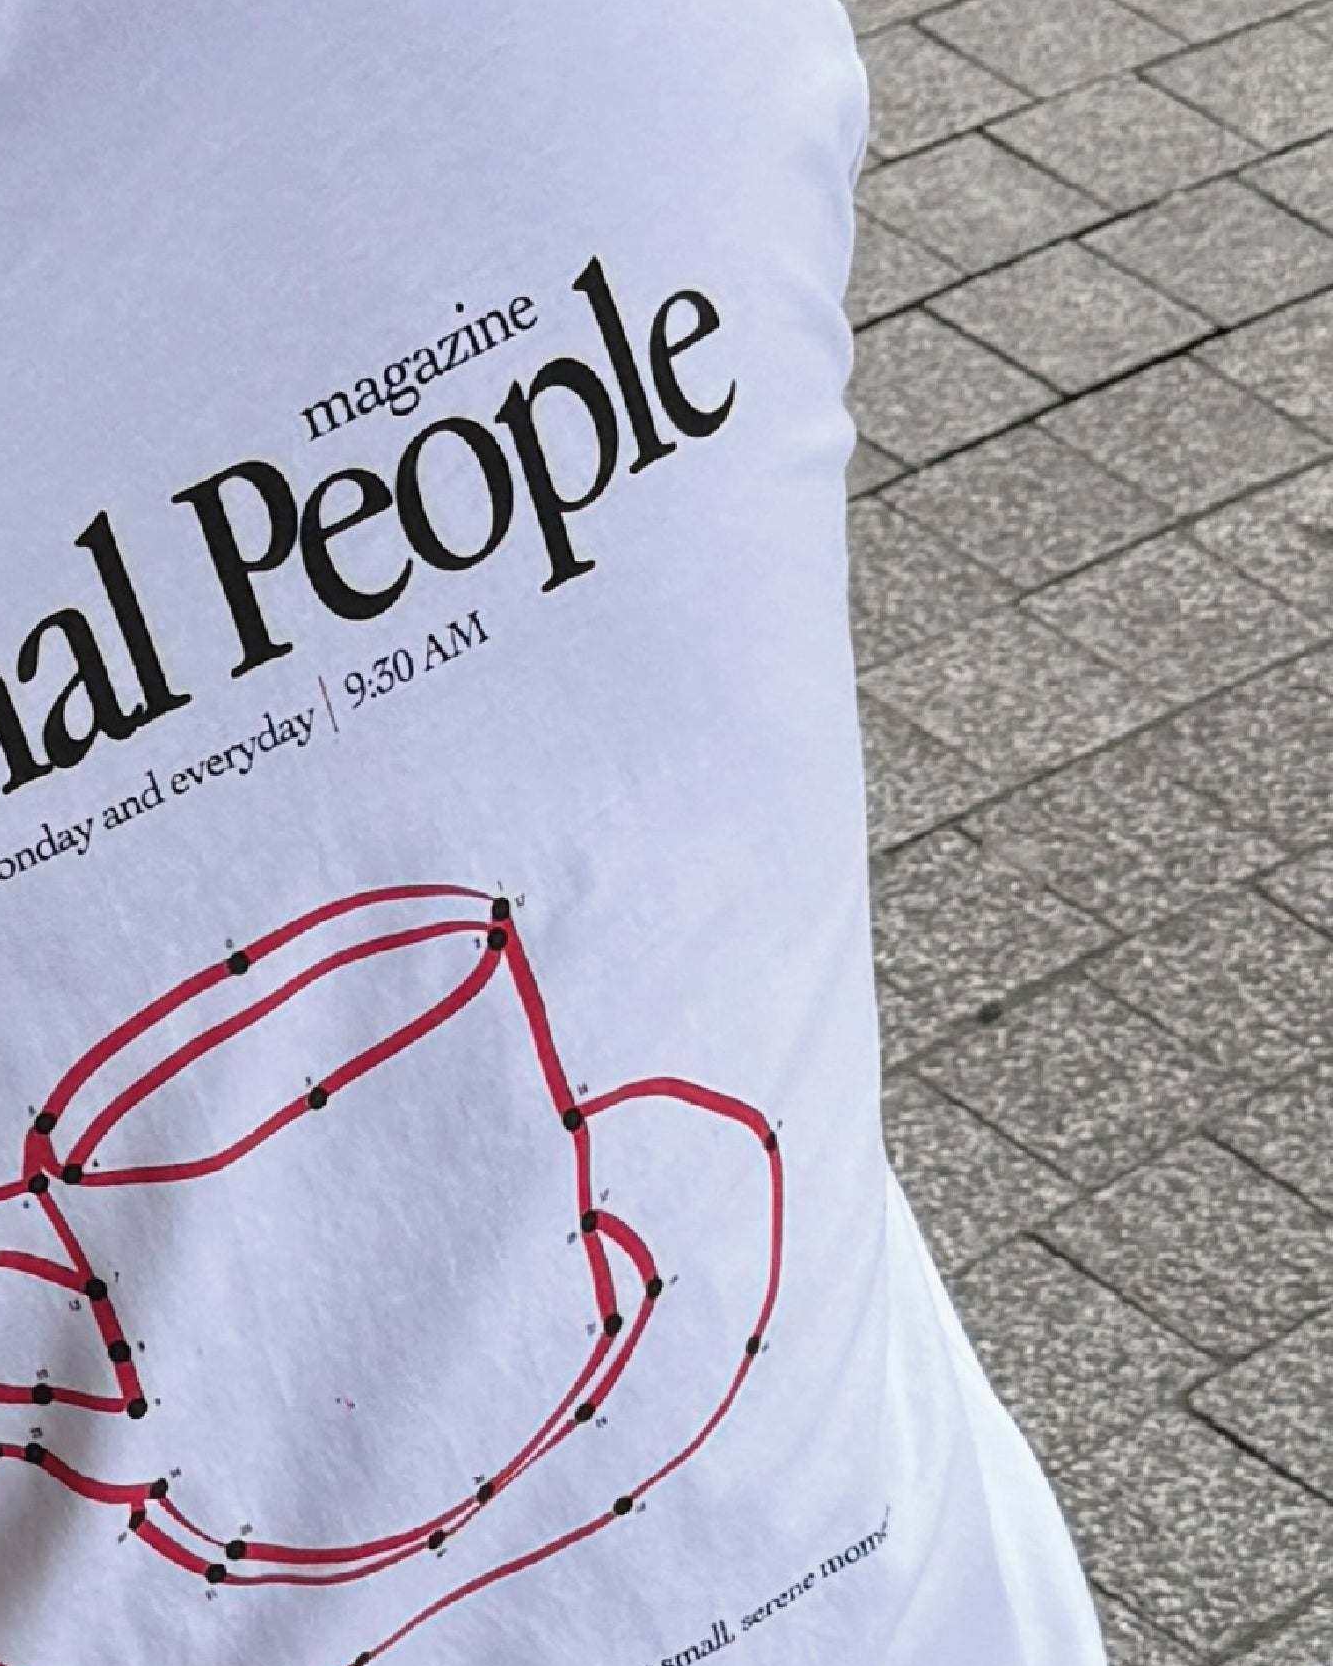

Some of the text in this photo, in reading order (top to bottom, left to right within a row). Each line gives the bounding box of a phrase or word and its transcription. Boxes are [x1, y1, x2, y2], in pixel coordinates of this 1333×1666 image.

[171, 255, 737, 679] People
[300, 296, 539, 442] magazine
[102, 768, 167, 830] and
[171, 707, 315, 797] everyday
[343, 648, 415, 710] 9:30
[424, 610, 491, 674] AM
